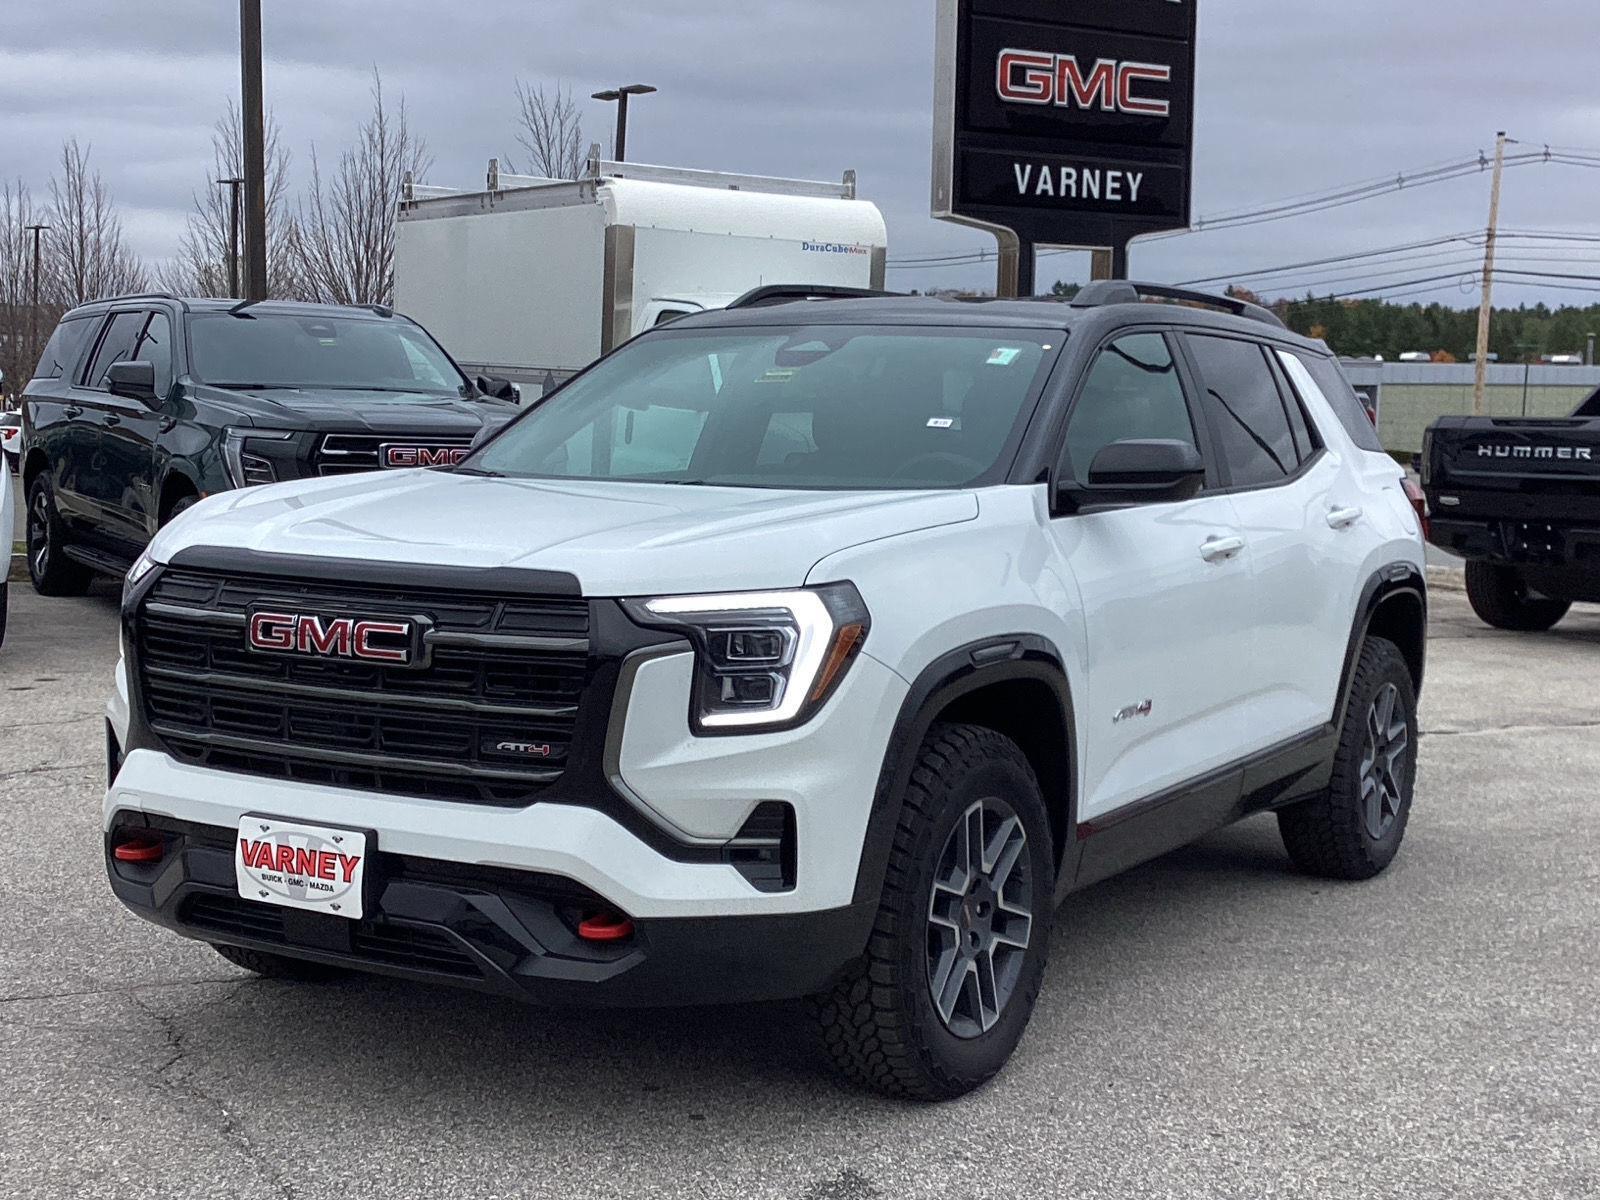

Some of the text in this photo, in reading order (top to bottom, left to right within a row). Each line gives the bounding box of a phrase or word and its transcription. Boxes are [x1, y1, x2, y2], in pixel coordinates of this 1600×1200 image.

[997, 48, 1171, 117] GMC
[1014, 163, 1143, 202] VARNEY
[1478, 444, 1591, 460] HUMMER
[250, 612, 409, 662] GMC
[497, 742, 550, 757] AT4
[240, 838, 361, 883] VARNEY
[261, 873, 334, 892] BUICK GMC MAZDA
